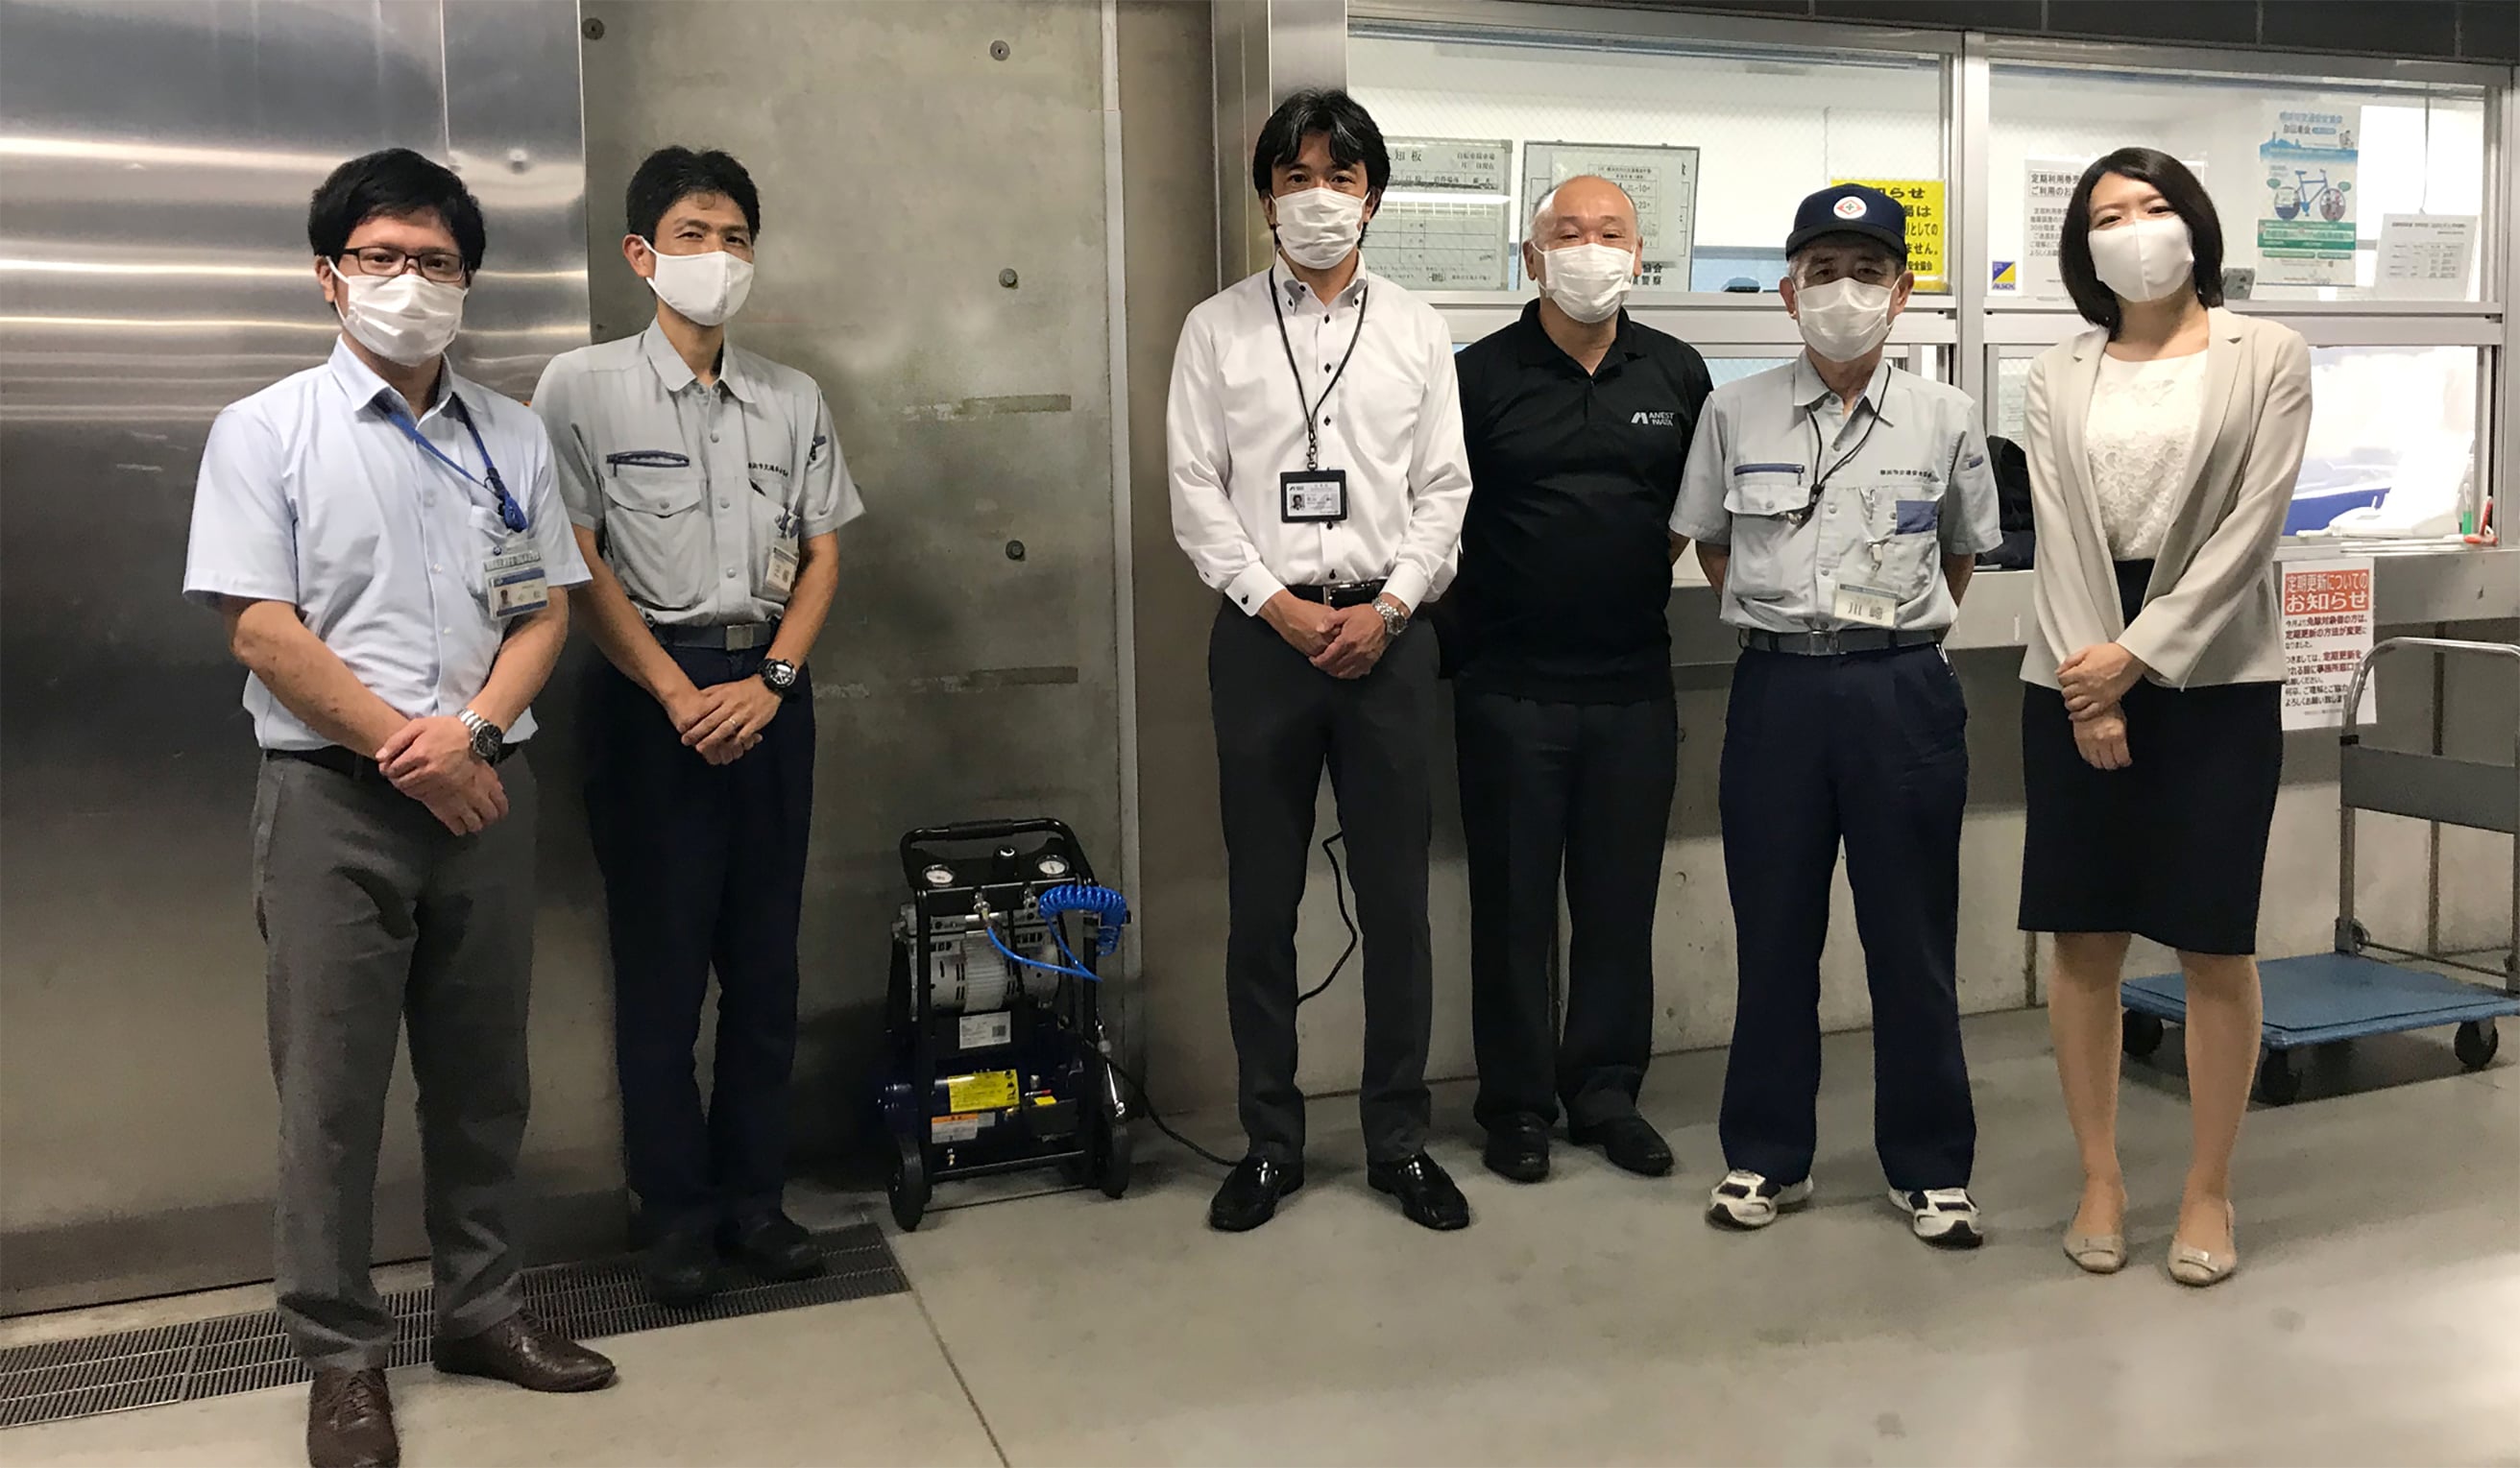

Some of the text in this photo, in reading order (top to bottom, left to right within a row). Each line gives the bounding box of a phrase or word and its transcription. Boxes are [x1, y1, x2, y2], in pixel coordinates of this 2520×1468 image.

[2286, 572, 2368, 593] 定期更新についての
[2287, 591, 2368, 613] お知らせ
